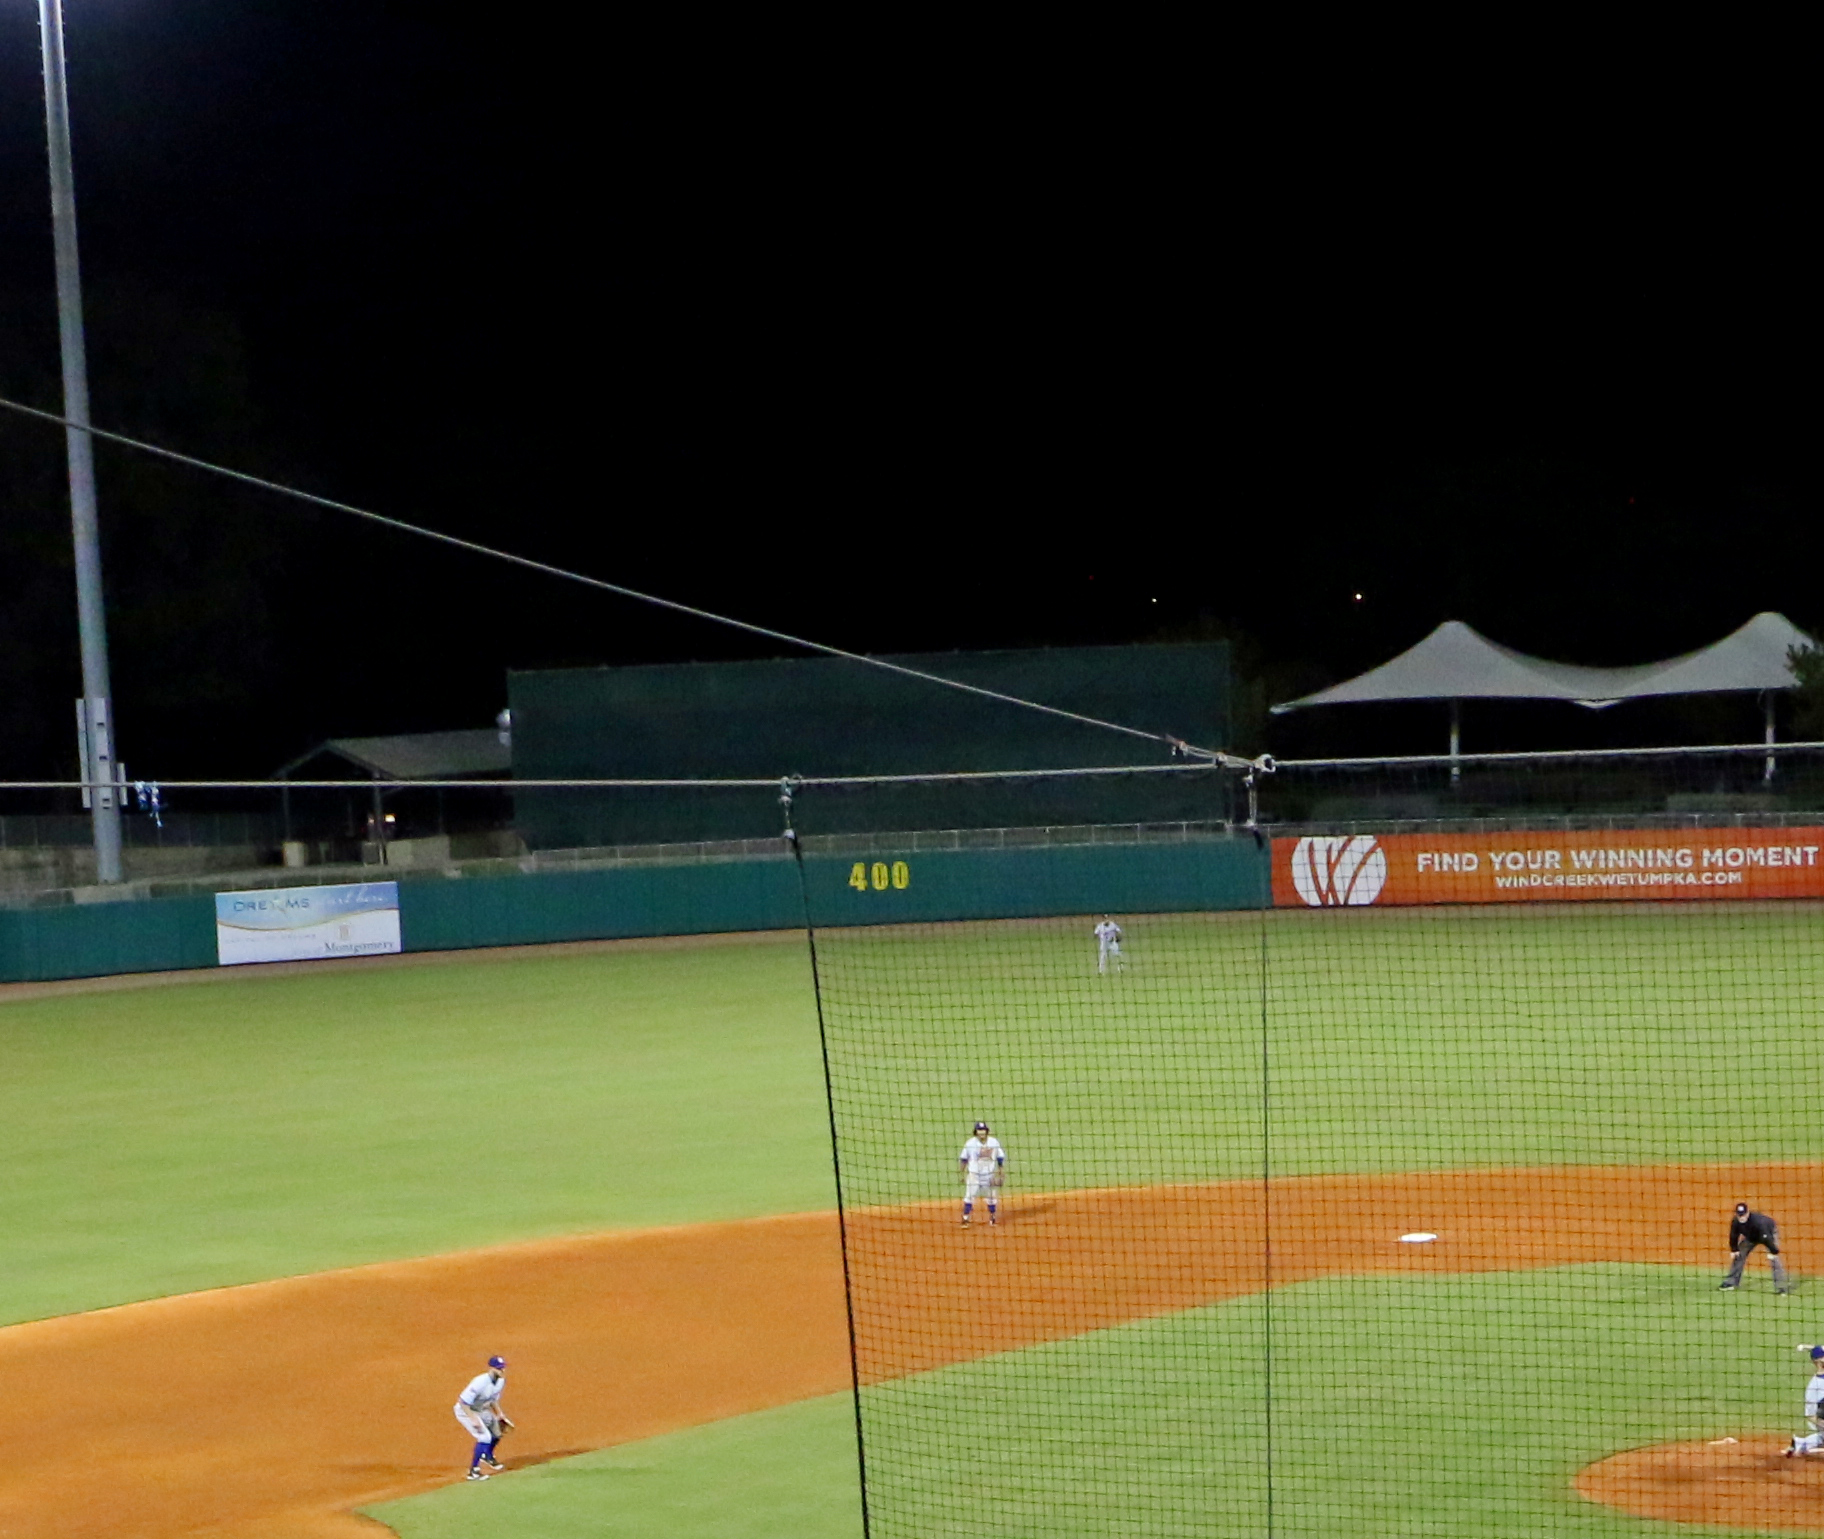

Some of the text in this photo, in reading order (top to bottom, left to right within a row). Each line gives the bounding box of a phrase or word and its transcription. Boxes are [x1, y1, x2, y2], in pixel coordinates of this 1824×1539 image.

[1417, 845, 1819, 873] FIND YOUR WINNING MOMENT
[849, 861, 910, 891] 400
[1496, 870, 1742, 889] WINDCREEKWETUMPKA.COM
[324, 941, 394, 954] Montgomery
